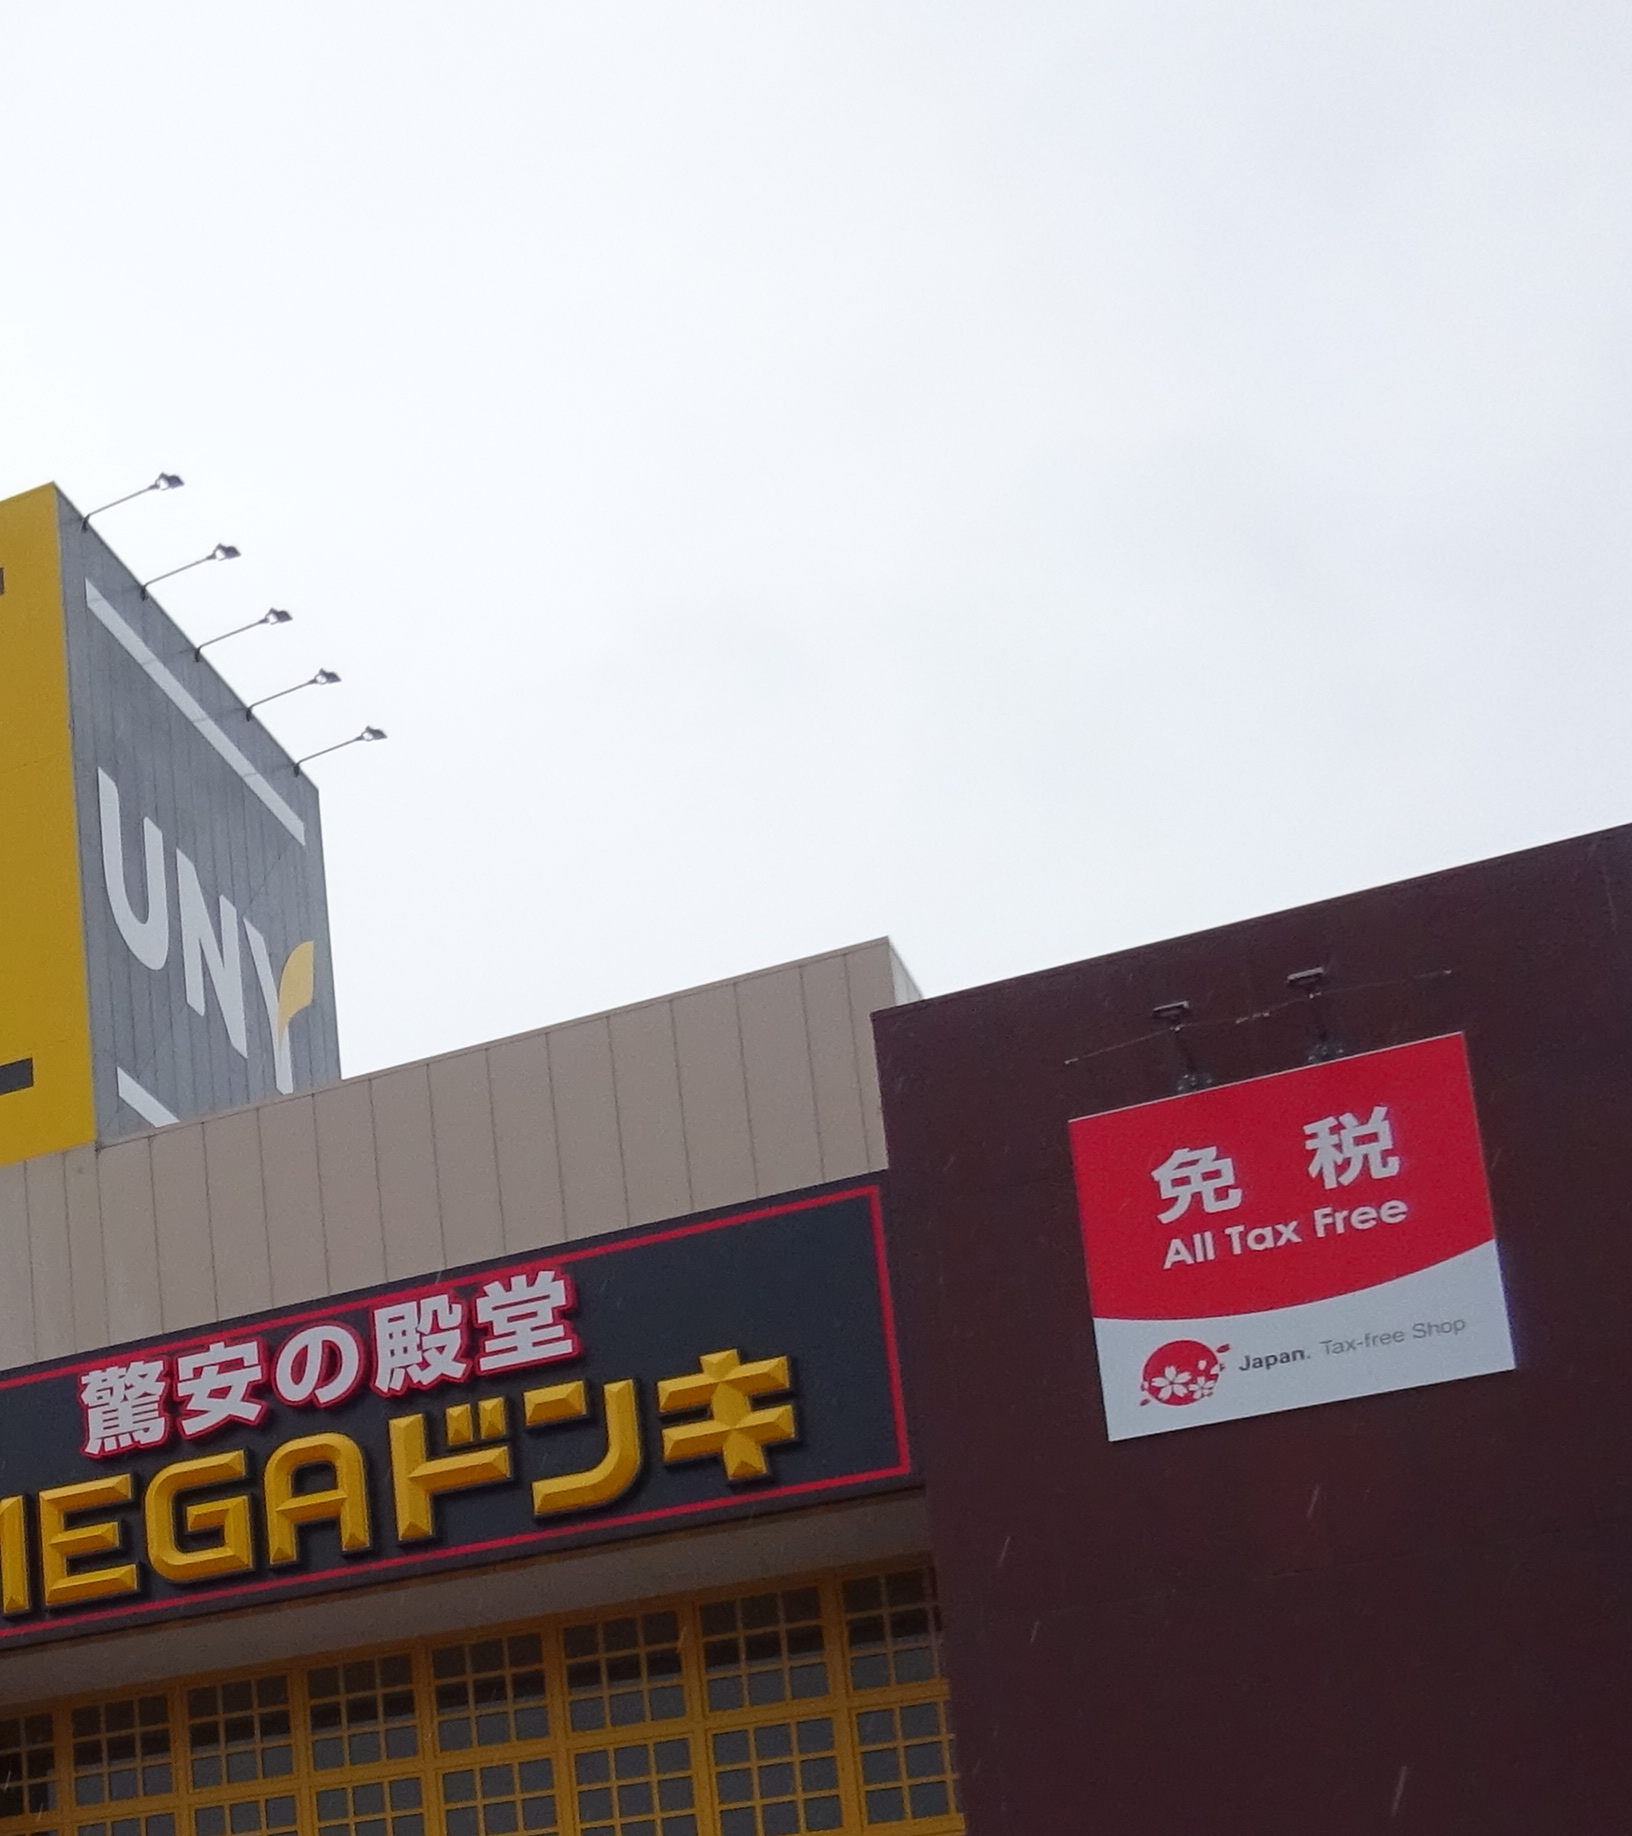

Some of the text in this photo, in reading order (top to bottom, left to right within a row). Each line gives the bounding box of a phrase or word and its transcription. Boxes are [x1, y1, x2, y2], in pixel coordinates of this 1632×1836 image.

[98, 766, 314, 1095] UNY
[1163, 1199, 1409, 1269] All Tax Free
[79, 1270, 578, 1455] 驚安の殿堂
[1239, 1317, 1466, 1372] Japan. Tax-free Shop
